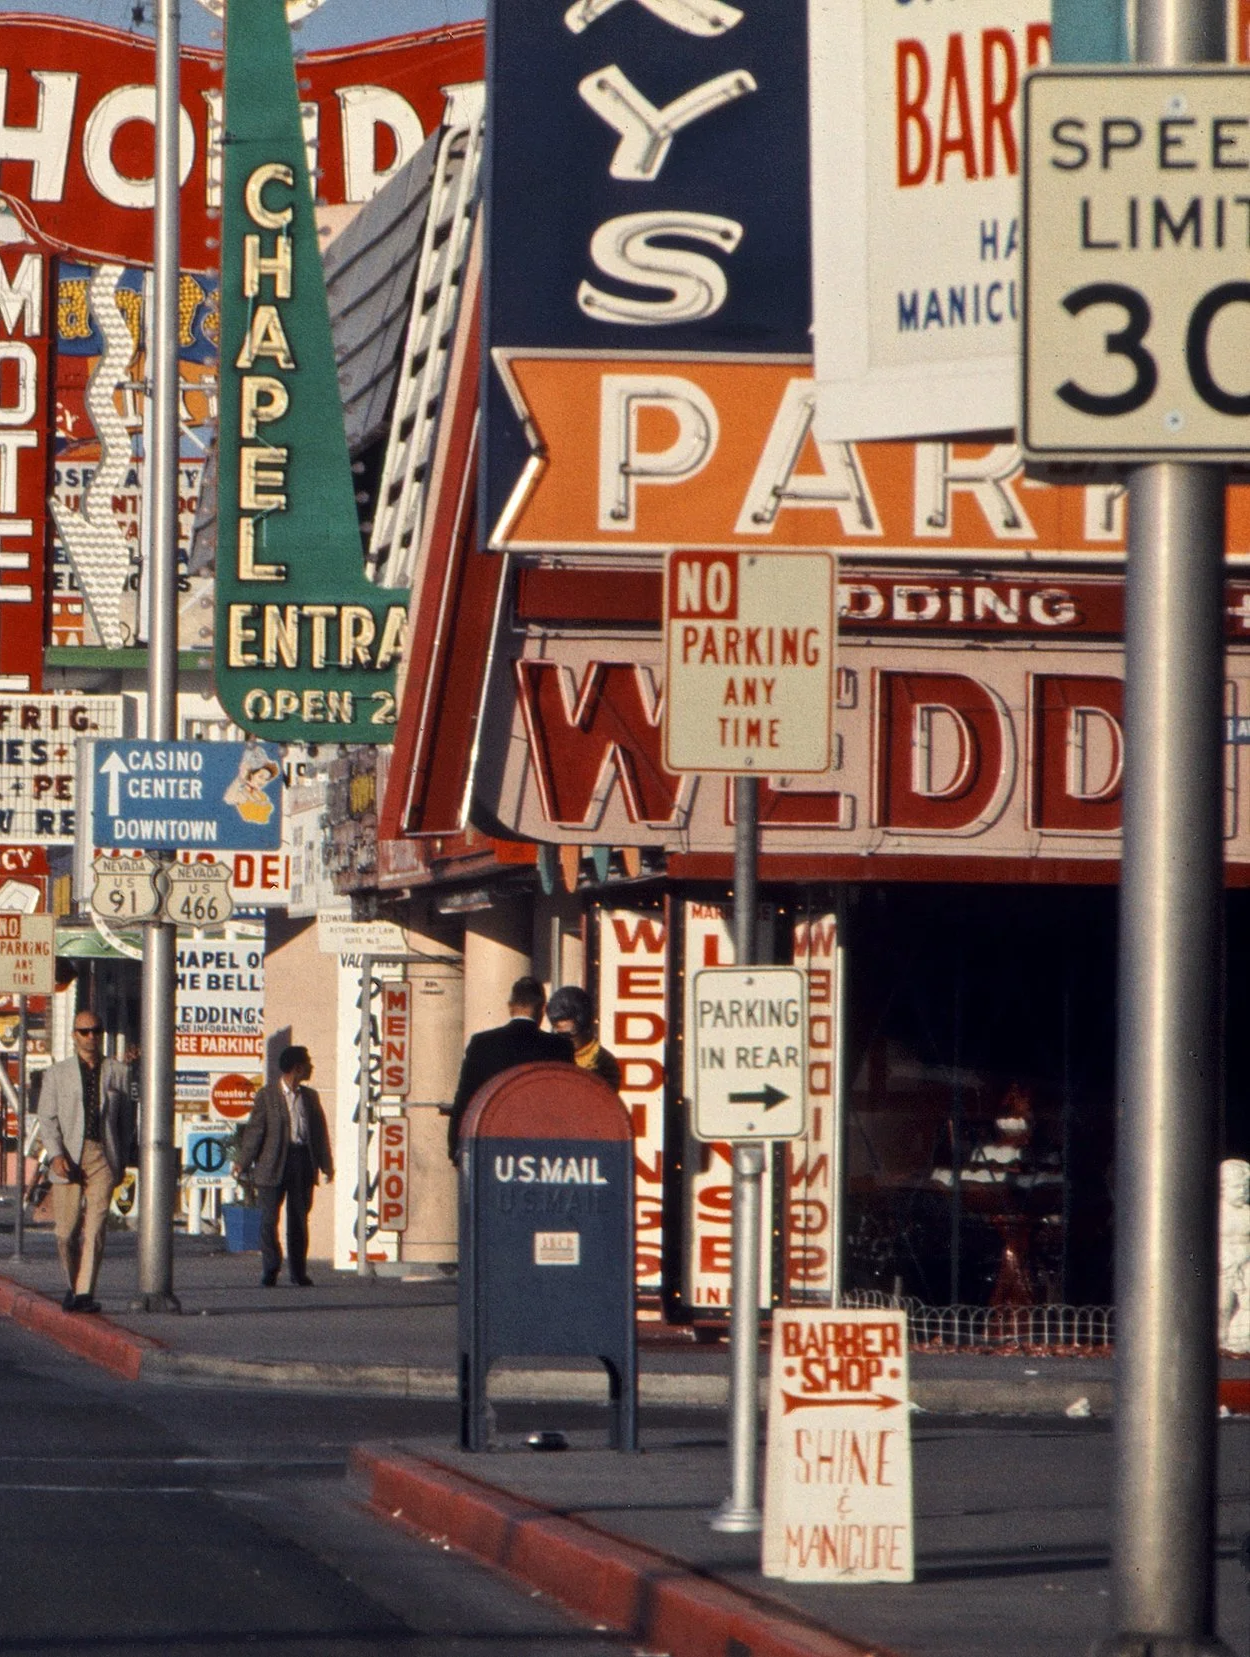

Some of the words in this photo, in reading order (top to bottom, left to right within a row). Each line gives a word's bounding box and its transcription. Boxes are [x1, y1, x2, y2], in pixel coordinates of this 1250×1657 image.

[1055, 281, 1250, 417] 30
[234, 162, 295, 581] CHAPEL
[676, 561, 733, 613] NO
[682, 626, 820, 667] PARKING
[243, 689, 352, 723] OPEN
[723, 677, 776, 706] ANY
[718, 718, 781, 748] TIME
[128, 751, 203, 771] CASINO
[128, 779, 203, 799] CENTER
[113, 820, 217, 842] DOWNTOWN
[102, 861, 146, 872] NEVADA
[177, 868, 221, 879] NEVADA
[108, 890, 138, 914] 91
[180, 896, 218, 920] 466
[0, 942, 50, 956] PARKING
[12, 973, 36, 986] TIME
[14, 960, 34, 971] ANY
[699, 999, 799, 1029] PARKING
[386, 991, 407, 1088] MENS
[700, 1046, 725, 1070] IN
[736, 1046, 799, 1070] REAR
[384, 1125, 404, 1223] SHOP
[781, 1321, 903, 1358] BARBER
[801, 1358, 884, 1393] SHOP
[794, 1428, 896, 1487] SHINE
[785, 1524, 907, 1571] MANICURE
